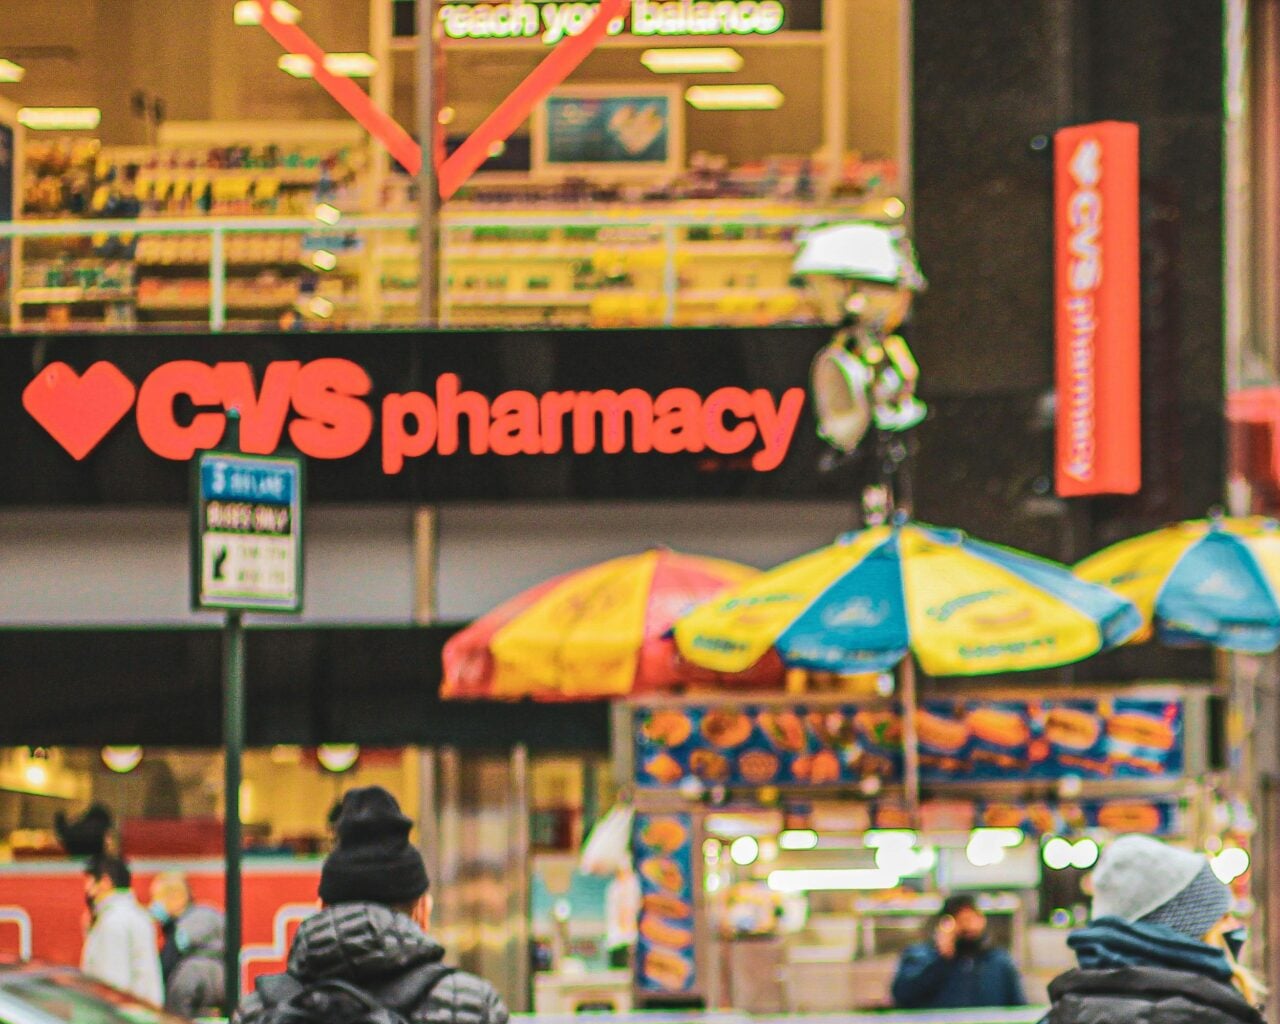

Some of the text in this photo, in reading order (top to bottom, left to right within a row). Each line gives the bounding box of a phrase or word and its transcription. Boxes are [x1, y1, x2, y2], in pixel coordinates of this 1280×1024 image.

[631, 0, 785, 34] balance
[1067, 190, 1103, 292] CVS
[136, 357, 806, 475] CVS pharmacy
